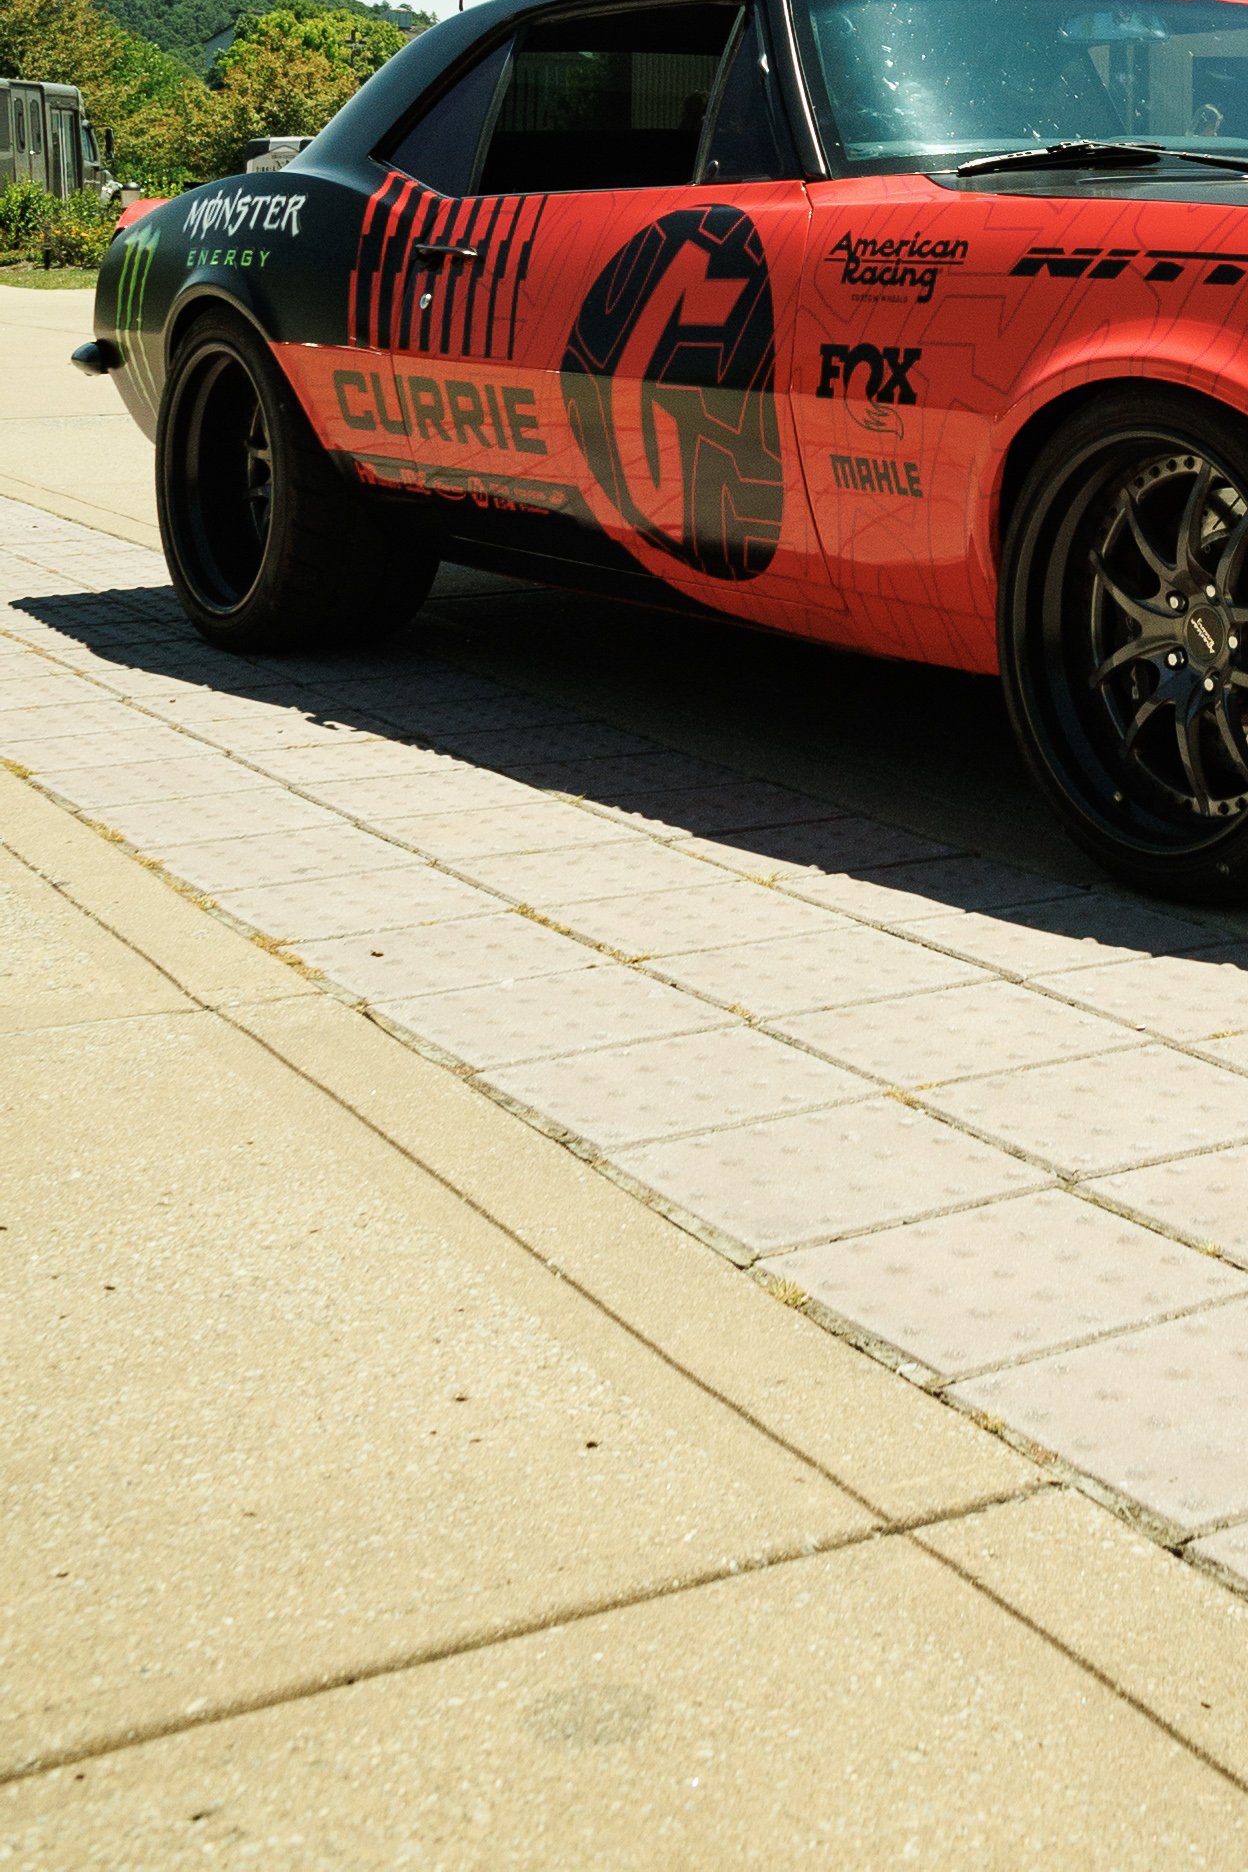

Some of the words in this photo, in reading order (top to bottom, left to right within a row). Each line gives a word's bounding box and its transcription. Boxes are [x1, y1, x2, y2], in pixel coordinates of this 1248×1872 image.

[186, 249, 270, 267] ENERGY
[828, 230, 969, 259] American
[840, 254, 939, 304] Racing
[815, 342, 922, 405] FOX
[332, 369, 548, 456] CURRIE
[829, 453, 924, 497] MAHLE
